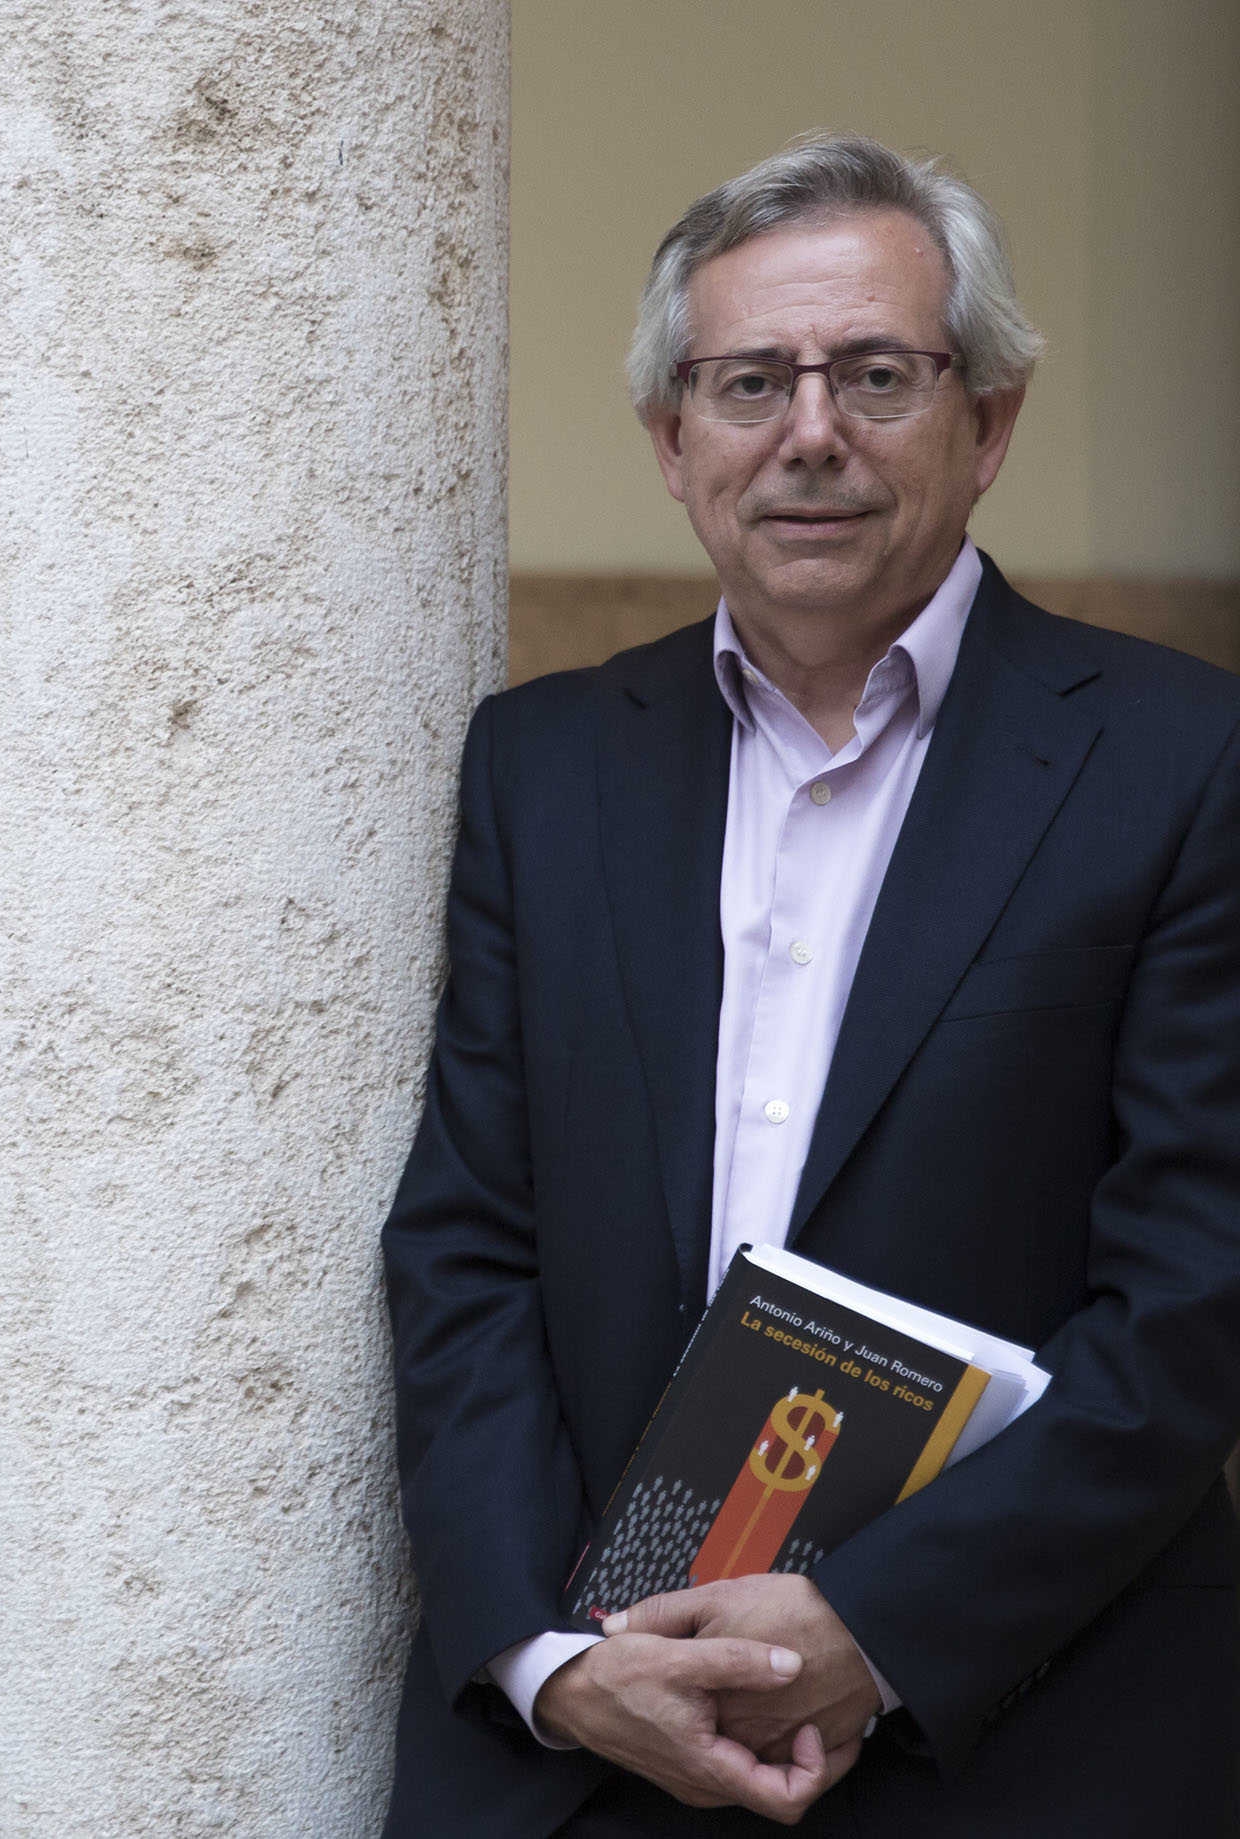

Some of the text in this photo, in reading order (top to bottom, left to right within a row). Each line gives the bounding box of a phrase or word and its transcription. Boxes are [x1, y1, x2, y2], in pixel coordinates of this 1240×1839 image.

[740, 1311, 934, 1411] La secesión de los ricos
[749, 1295, 943, 1393] Antonio Ariño y Juan Romero
